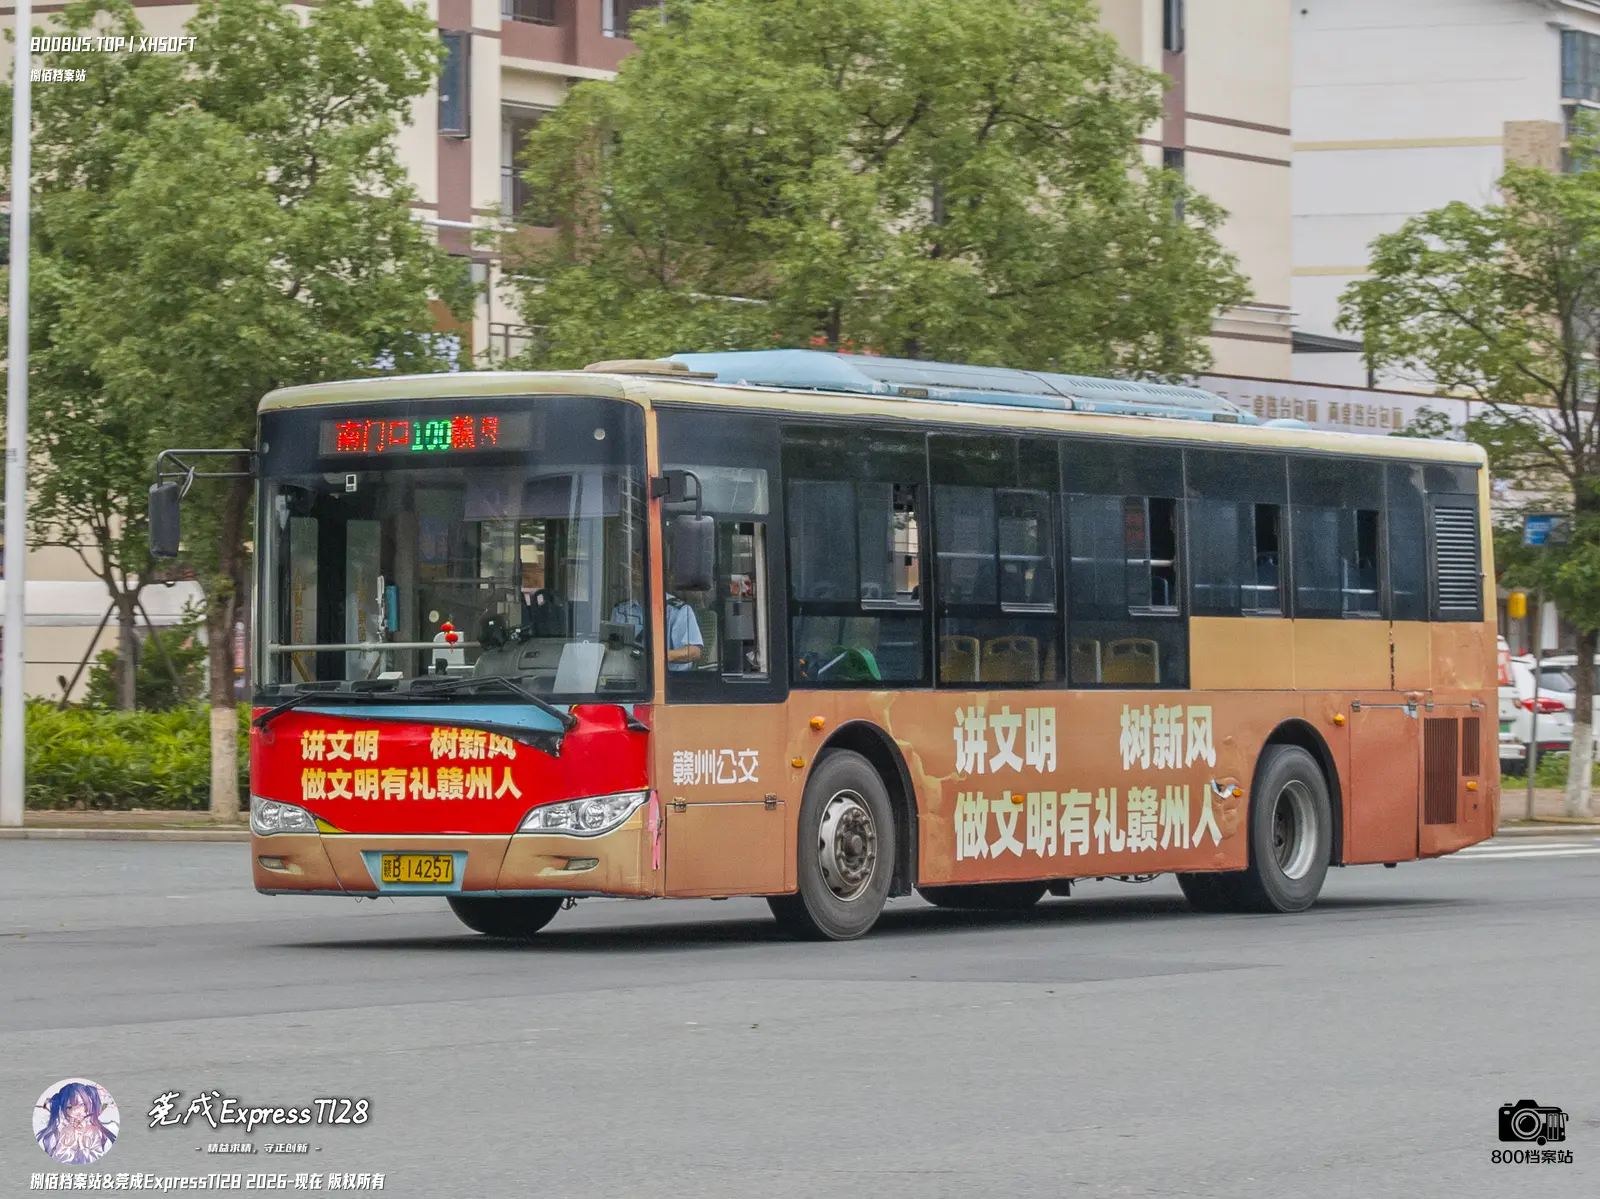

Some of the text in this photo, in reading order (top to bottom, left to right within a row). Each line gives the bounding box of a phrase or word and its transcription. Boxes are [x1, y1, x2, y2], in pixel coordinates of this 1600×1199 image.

[301, 727, 516, 761] 讲文明 树新风
[953, 704, 1217, 775] 讲文明 树新风
[301, 766, 523, 801] 做文明有礼赣州人
[672, 748, 759, 786] 赣州公交
[953, 784, 1223, 861] 做文明有礼赣州人
